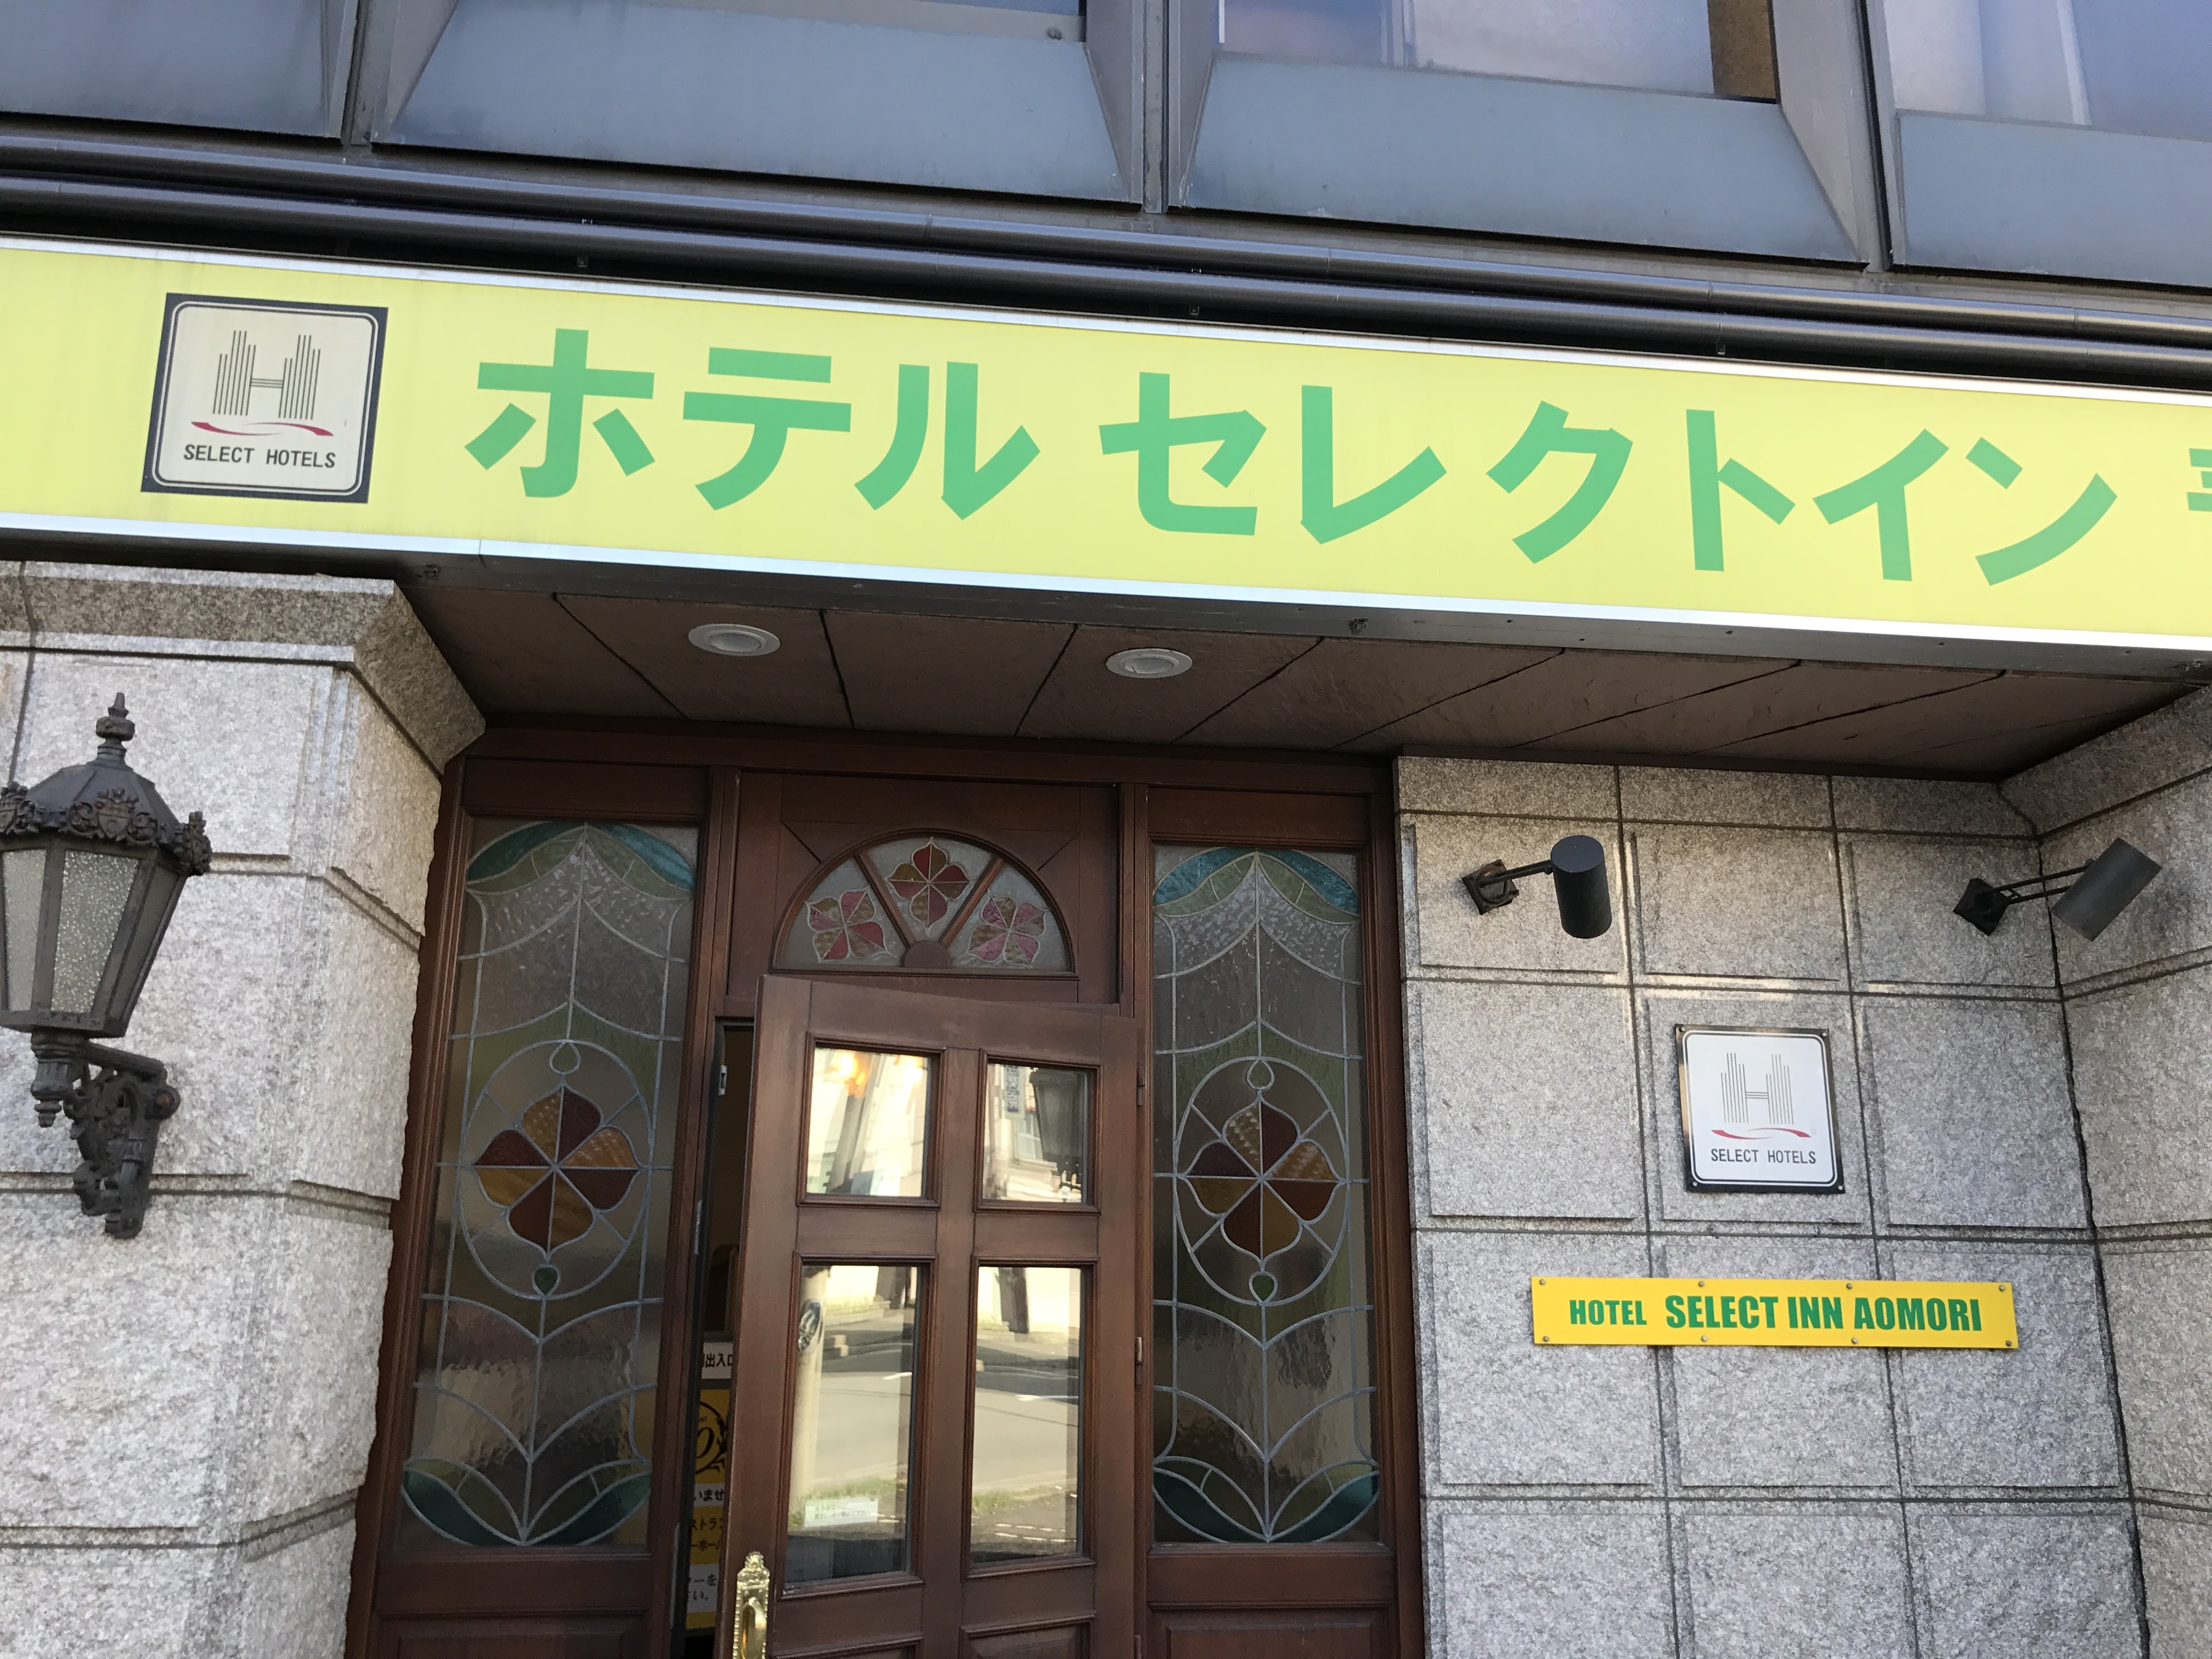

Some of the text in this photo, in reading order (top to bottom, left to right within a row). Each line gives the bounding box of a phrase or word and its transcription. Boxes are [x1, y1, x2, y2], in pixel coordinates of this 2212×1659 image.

[464, 328, 1041, 521] ホテル
[183, 444, 336, 469] SELECT HOTELS
[1711, 1148, 1816, 1165] SELECT HOTELS
[1570, 1295, 1982, 1331] HOTEL SELECT INN AOMORI
[703, 1353, 733, 1368] 出入口
